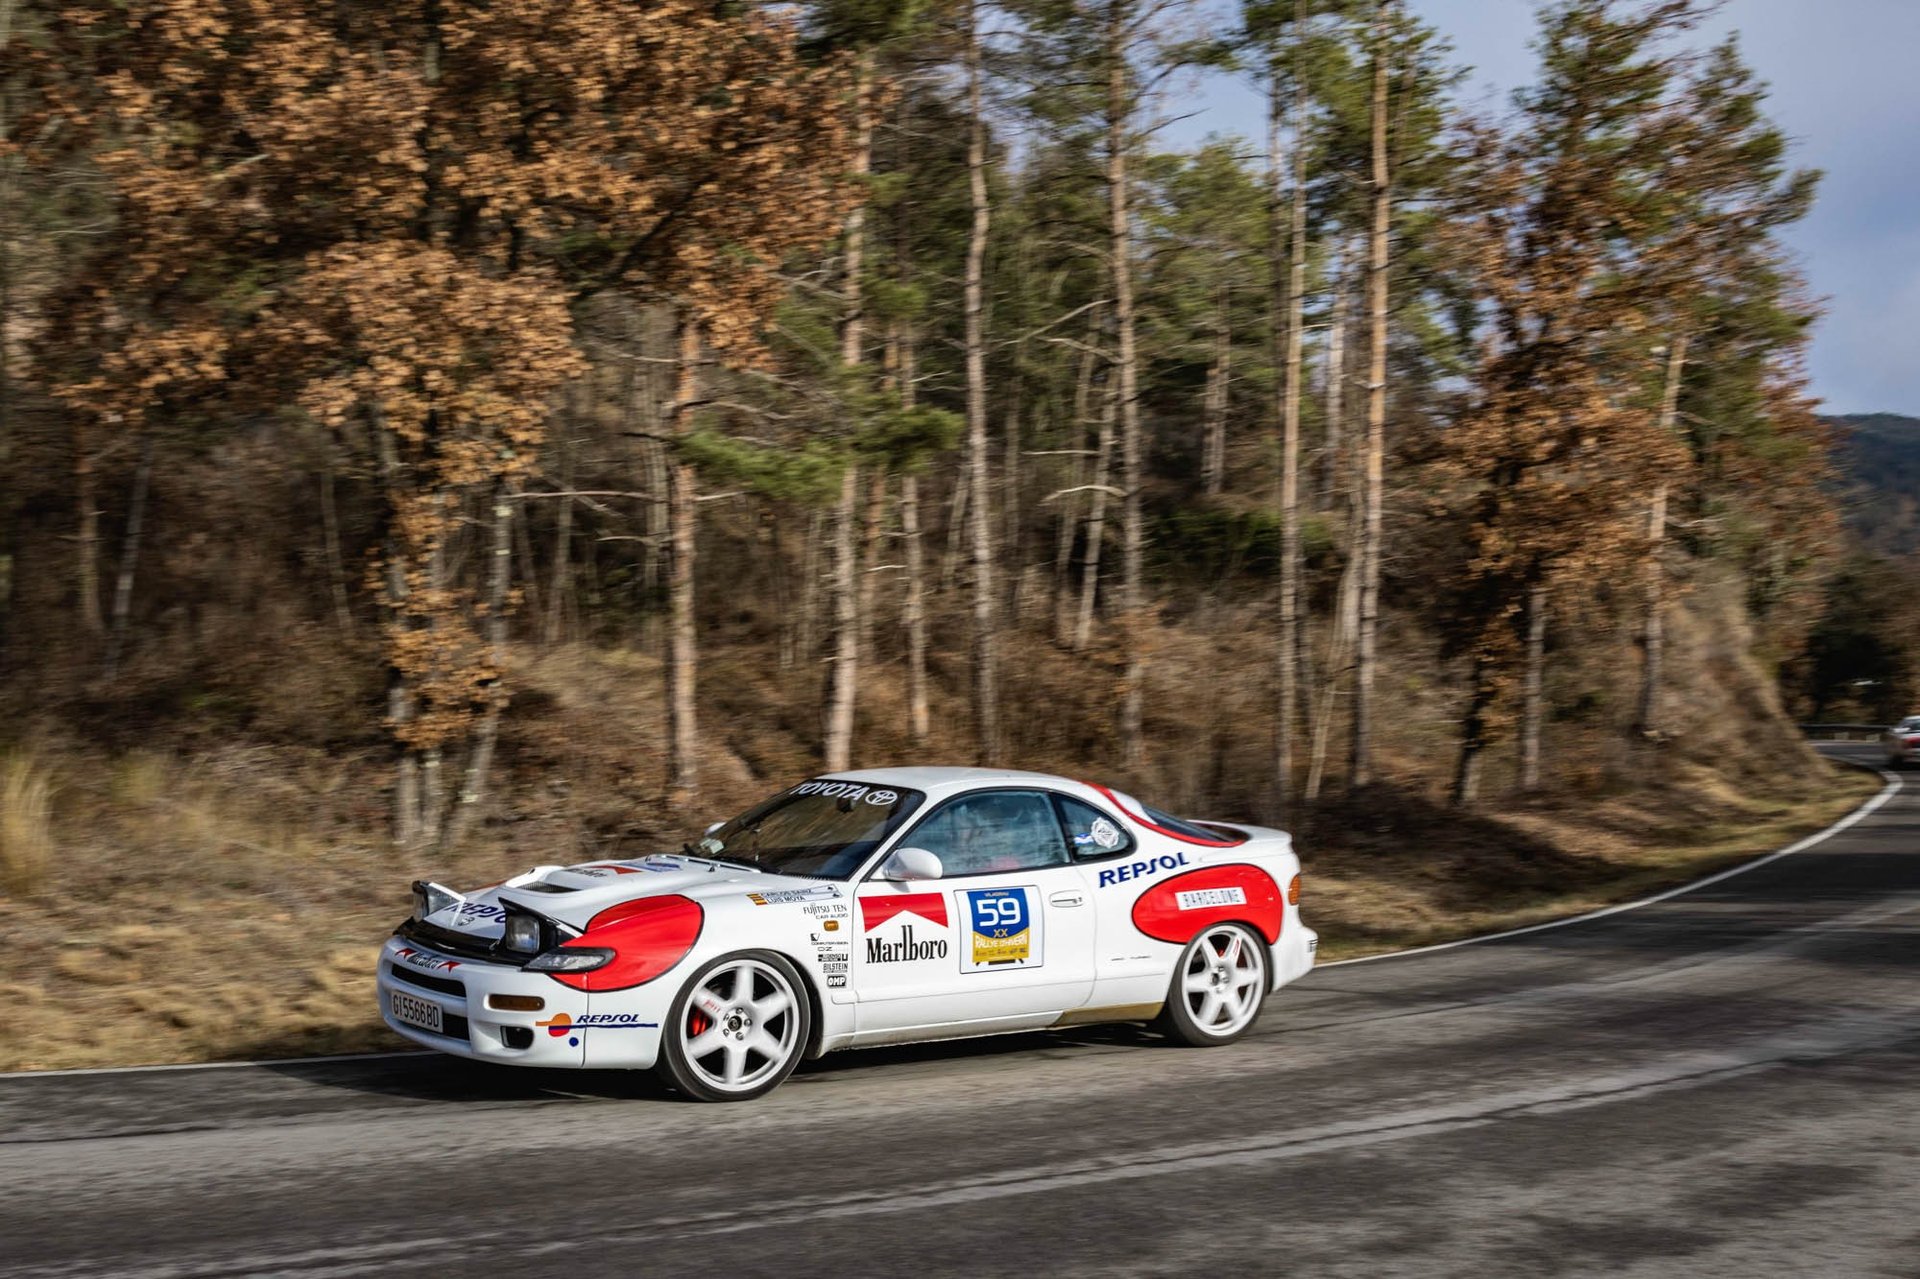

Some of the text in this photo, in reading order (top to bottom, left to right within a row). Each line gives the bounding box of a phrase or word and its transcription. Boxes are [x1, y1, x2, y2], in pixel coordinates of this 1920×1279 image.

[789, 782, 869, 800] TOYOTA
[1099, 852, 1190, 888] REPSOL
[767, 895, 806, 904] LUIS MOYA
[803, 902, 847, 915] FUJITSU TEN
[976, 897, 1021, 927] 59
[994, 928, 1008, 938] XX
[866, 925, 947, 964] Marlboro
[823, 963, 849, 971] BILSTEIN
[827, 976, 846, 987] OMP
[576, 1014, 639, 1024] REPSOL
